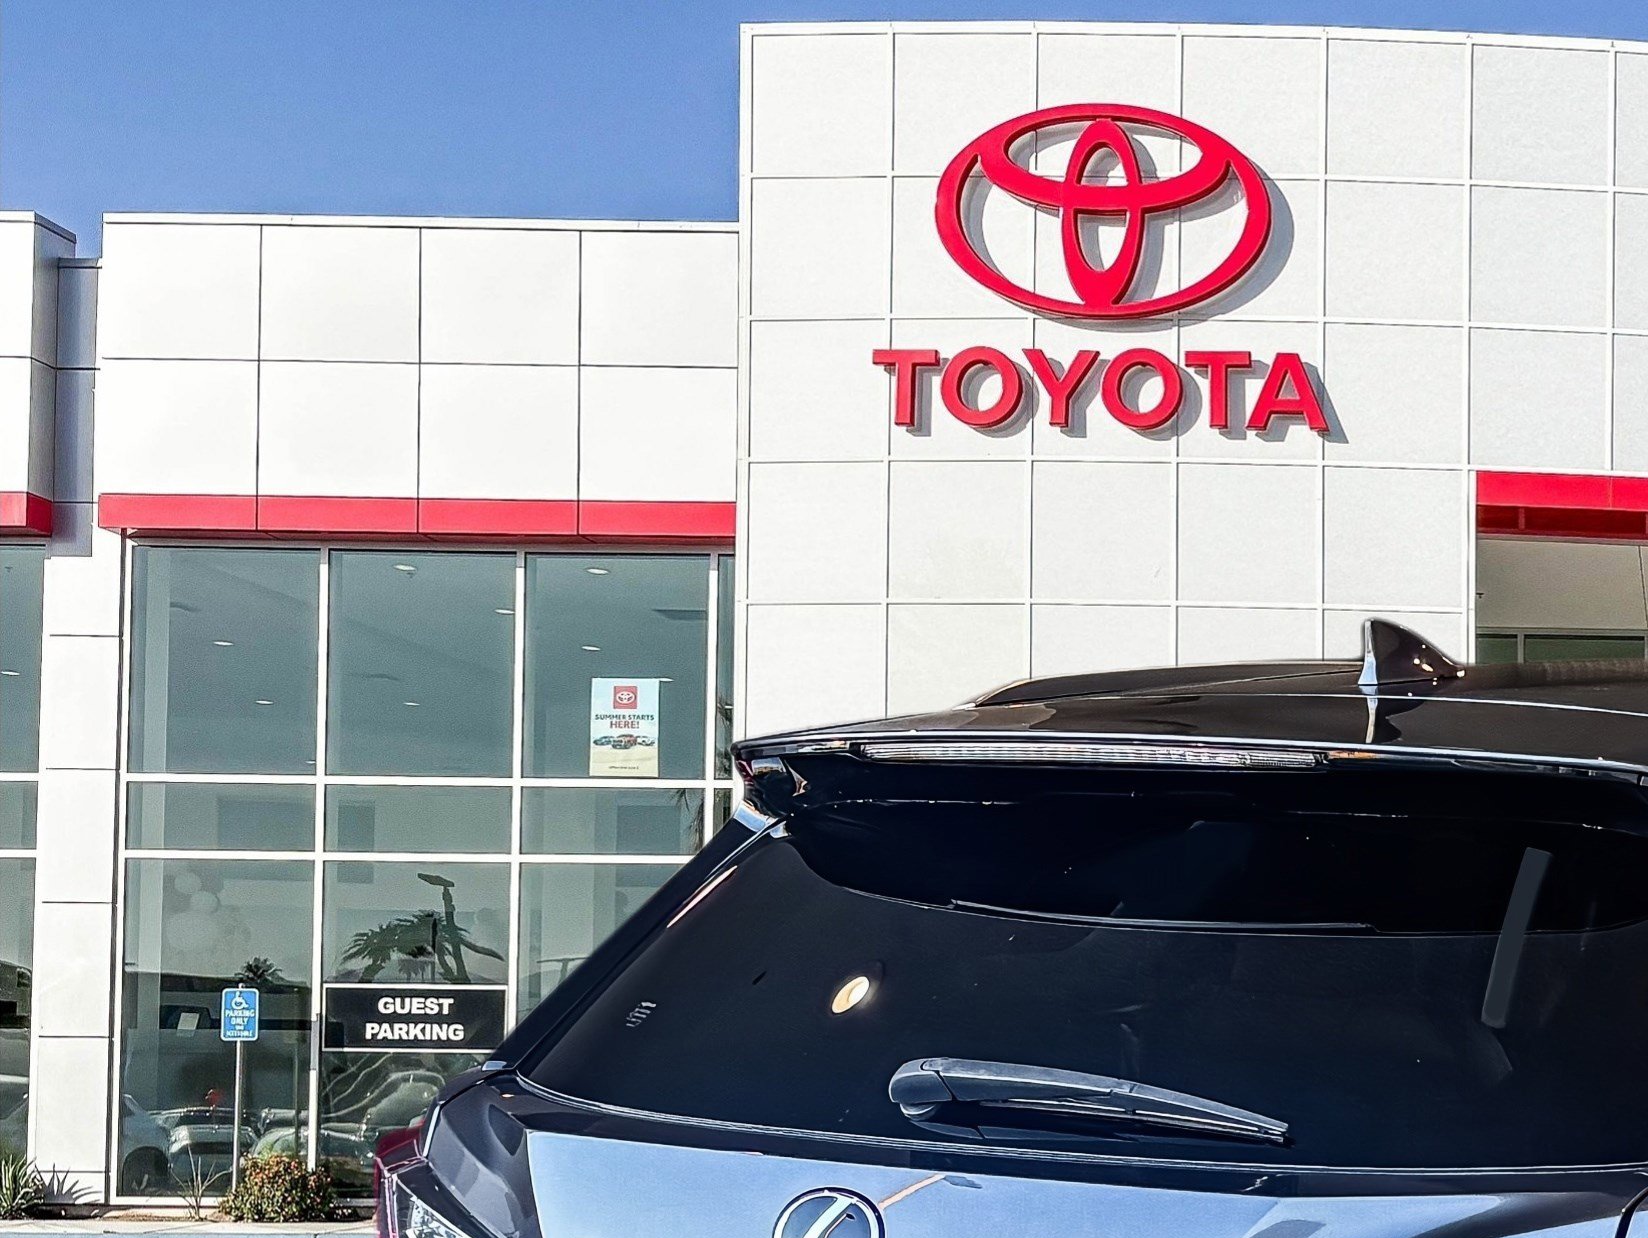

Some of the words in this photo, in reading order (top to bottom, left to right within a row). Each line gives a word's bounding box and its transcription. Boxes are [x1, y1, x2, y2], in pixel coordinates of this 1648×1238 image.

[873, 346, 1329, 432] TOYOTA
[609, 720, 640, 729] HERE!
[377, 997, 454, 1015] GUEST
[365, 1023, 464, 1040] PARKING
